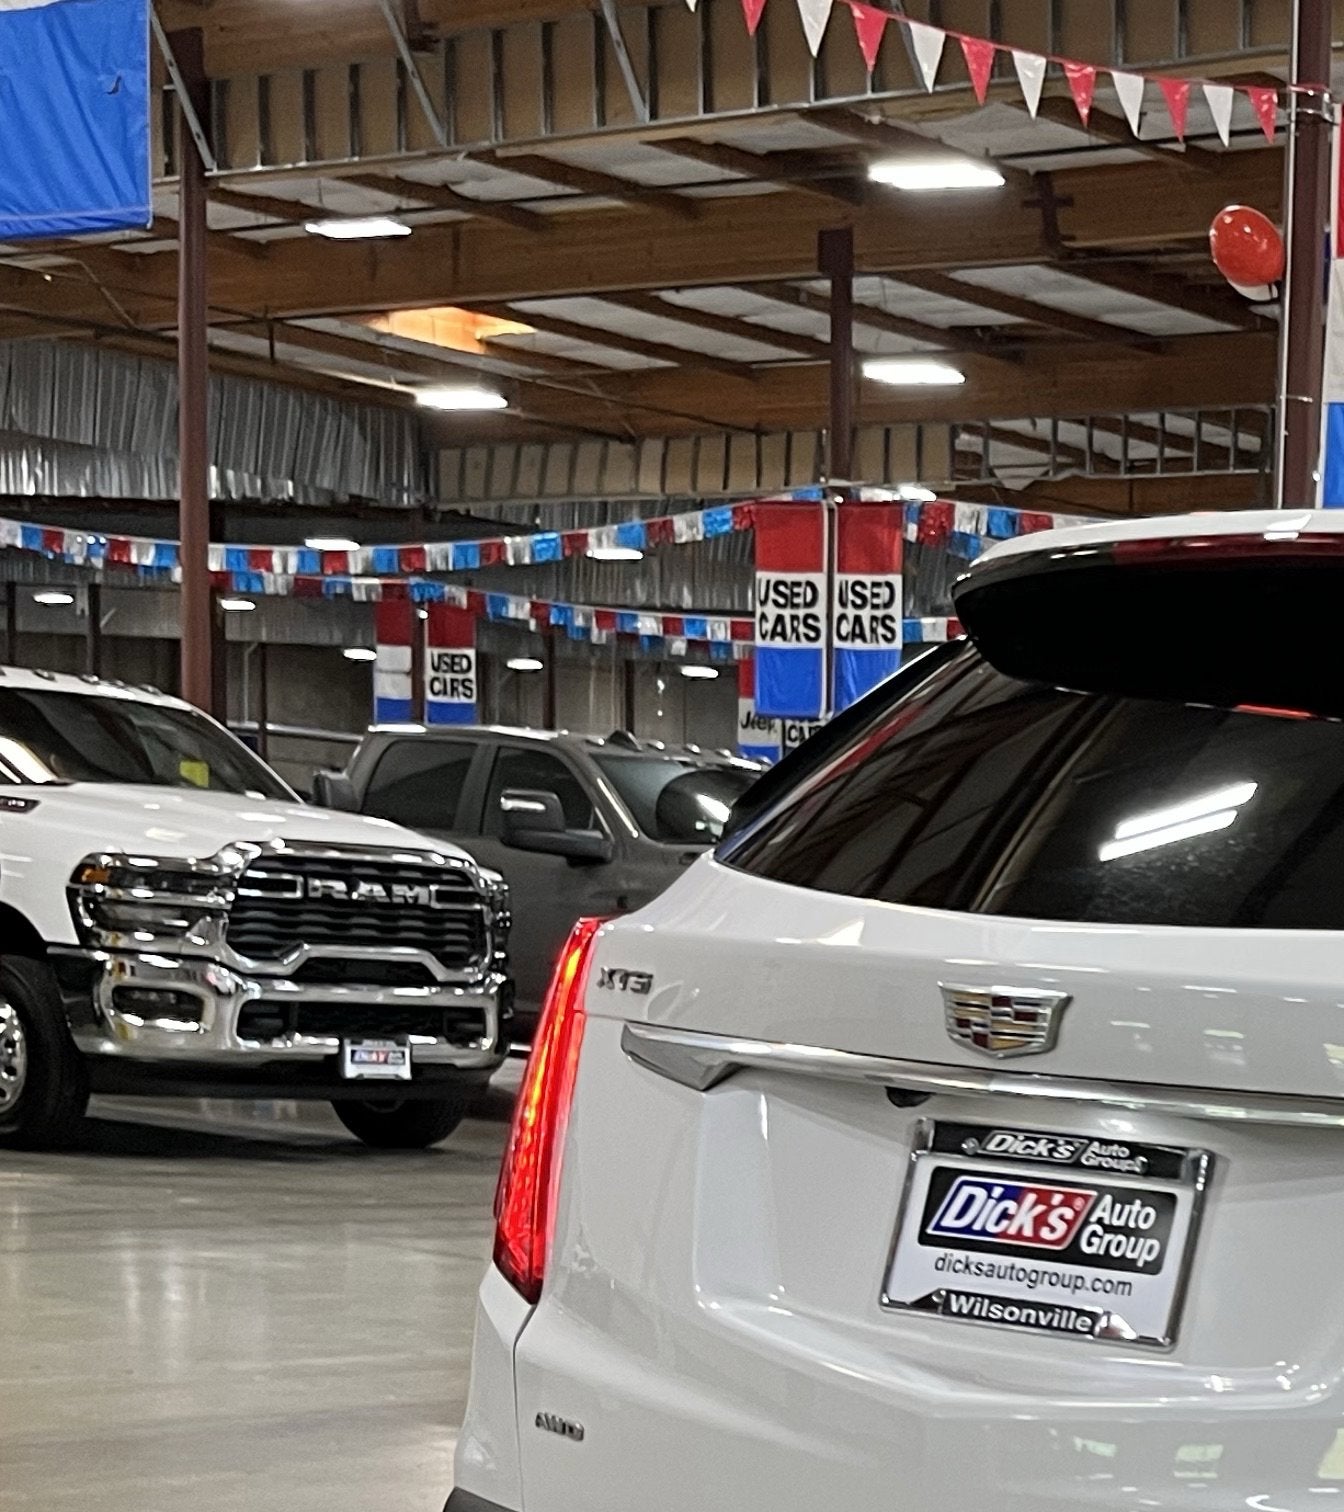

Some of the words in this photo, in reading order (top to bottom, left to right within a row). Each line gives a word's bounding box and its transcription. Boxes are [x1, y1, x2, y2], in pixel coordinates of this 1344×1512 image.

[759, 579, 819, 610] USED
[839, 580, 895, 611] USED
[758, 613, 821, 644] CARS
[836, 614, 896, 645] CARS
[431, 651, 472, 675] USED
[307, 876, 430, 905] RAM
[986, 1133, 1076, 1160] Dick's
[1085, 1140, 1131, 1159] Auto
[940, 1184, 1075, 1242] Dick's
[1089, 1194, 1157, 1231] Auto
[1079, 1223, 1161, 1268] Group
[934, 1251, 1134, 1298] dicksautogroup.com
[949, 1292, 1095, 1334] Wilsonville
